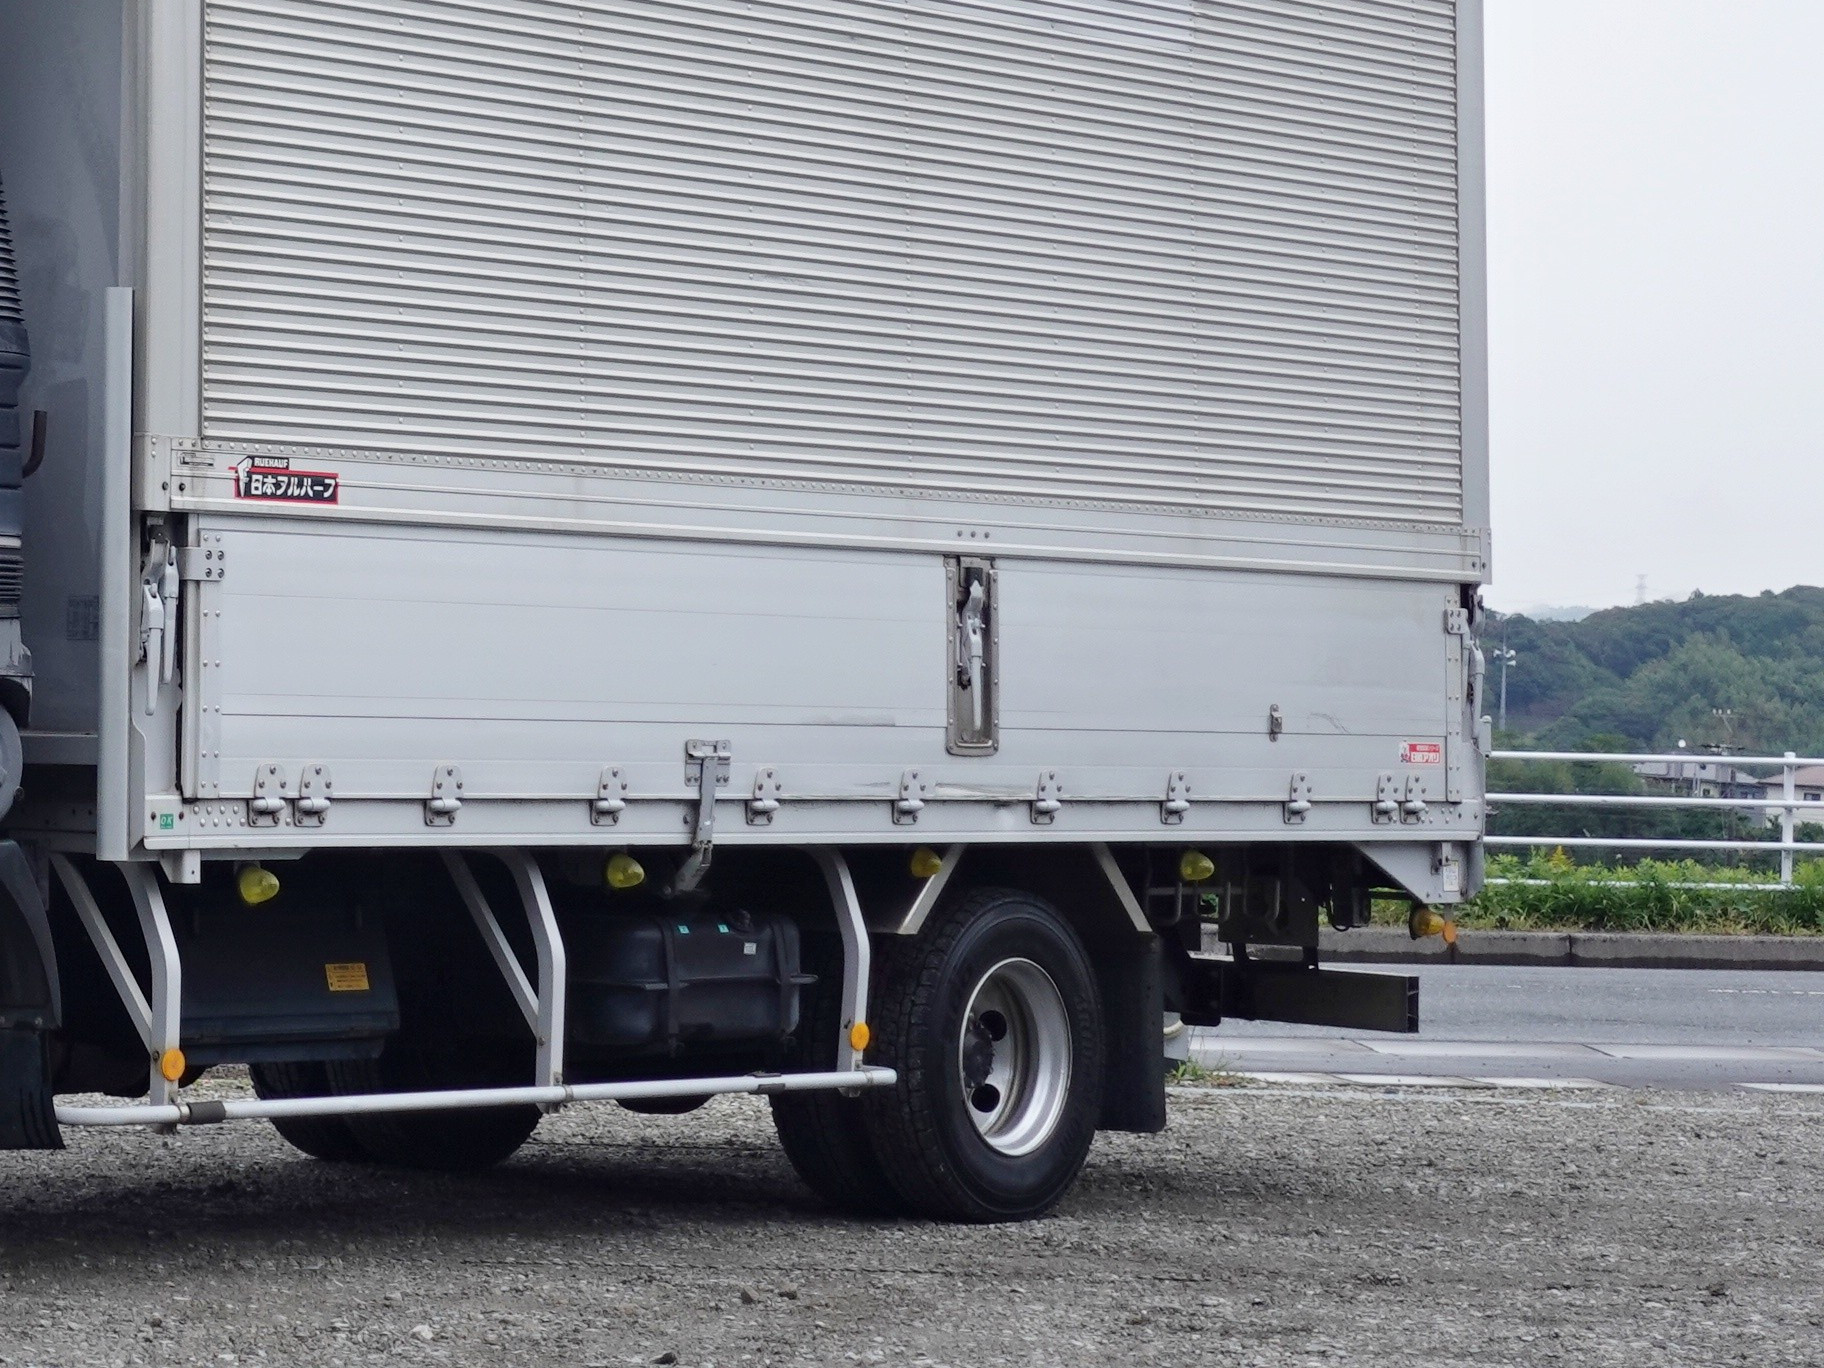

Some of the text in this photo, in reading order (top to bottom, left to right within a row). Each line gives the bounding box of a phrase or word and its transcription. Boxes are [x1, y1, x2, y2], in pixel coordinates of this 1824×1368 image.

[251, 474, 336, 498] 日本フルハーフ
